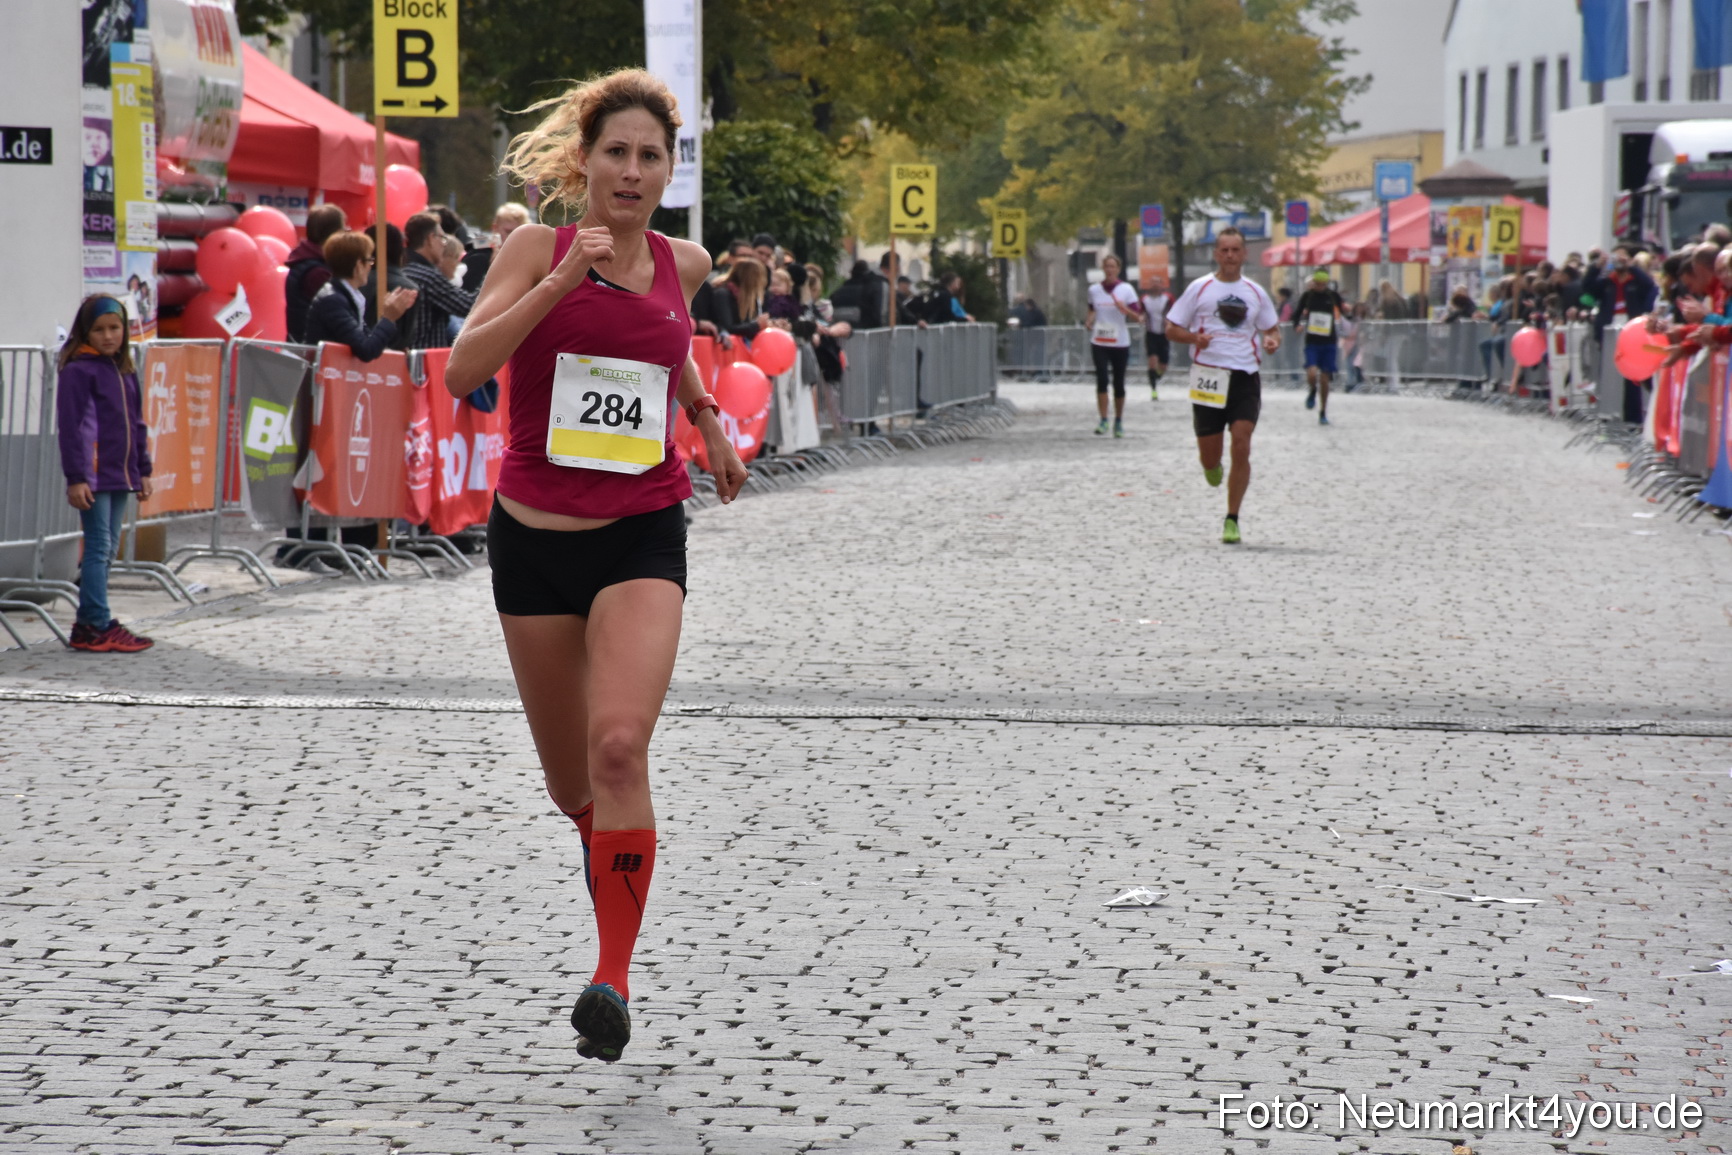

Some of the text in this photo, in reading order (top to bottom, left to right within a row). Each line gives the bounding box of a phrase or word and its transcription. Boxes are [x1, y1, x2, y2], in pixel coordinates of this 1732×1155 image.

[384, 0, 447, 18] Block
[396, 28, 437, 88] B
[896, 167, 931, 180] Block
[902, 185, 924, 217] C
[1001, 224, 1017, 246] D
[1497, 220, 1515, 243] D
[602, 368, 641, 382] BOCK
[1197, 377, 1219, 391] 244
[556, 416, 562, 424] D
[579, 391, 643, 430] 284
